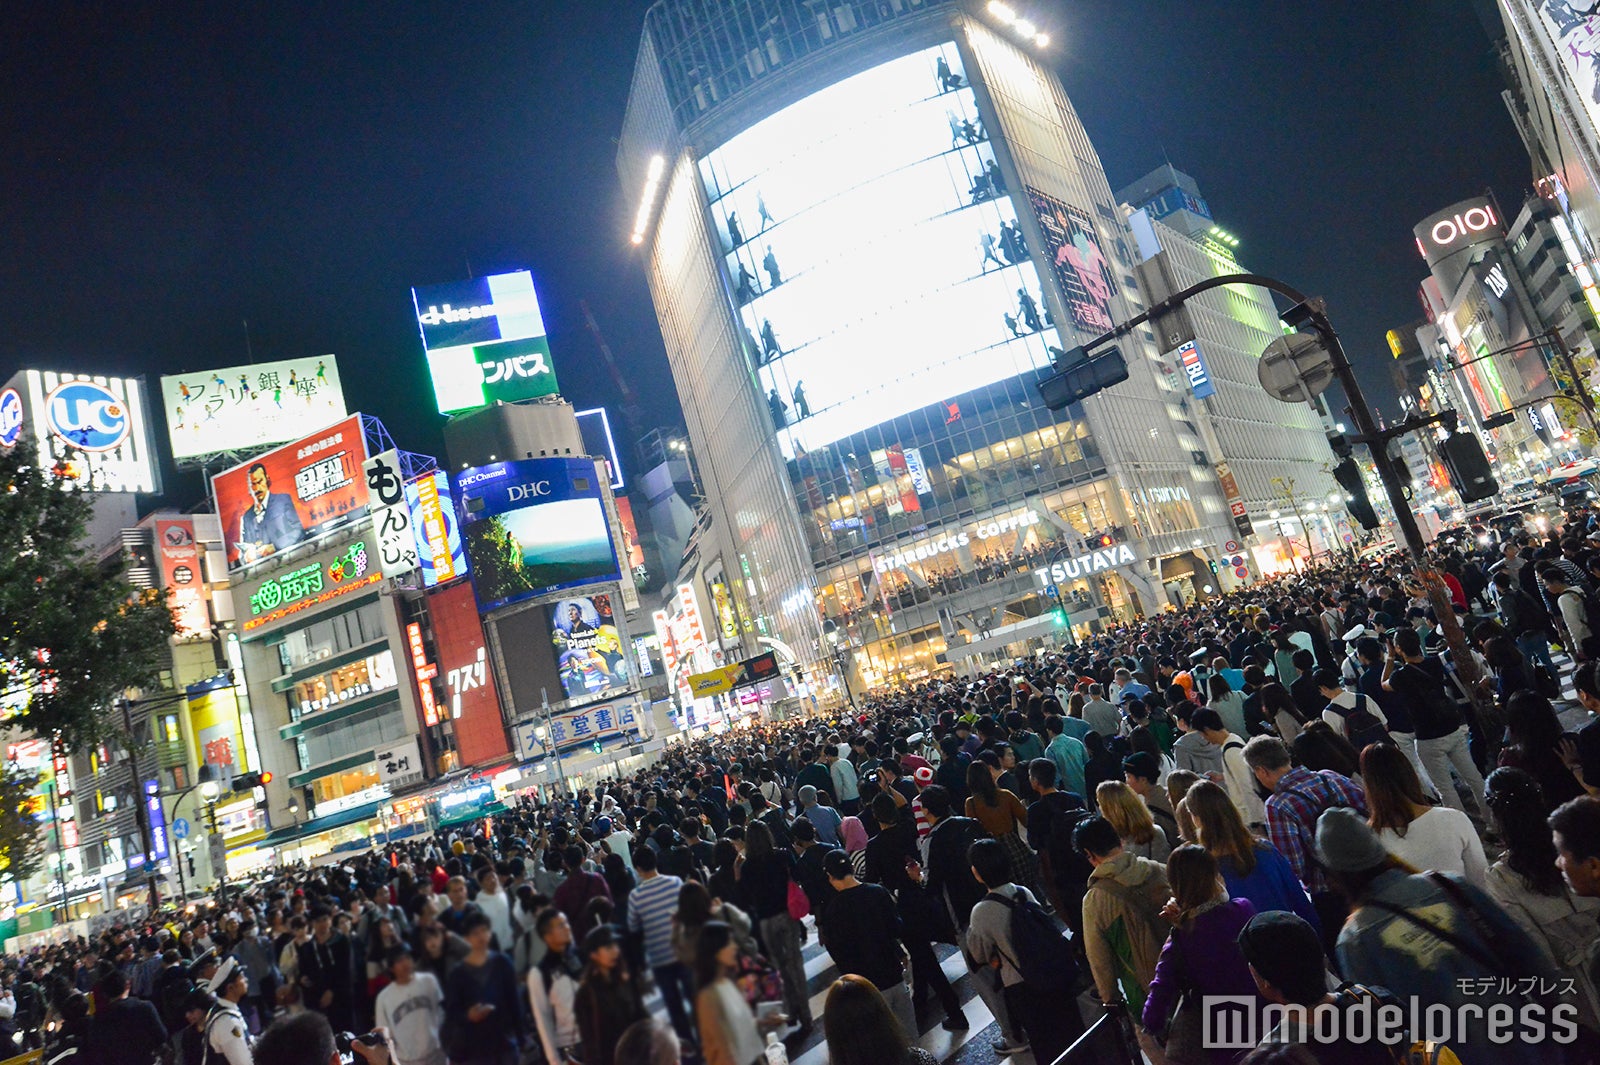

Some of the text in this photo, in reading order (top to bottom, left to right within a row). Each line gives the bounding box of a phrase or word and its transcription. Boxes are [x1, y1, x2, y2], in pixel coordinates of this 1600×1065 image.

[481, 353, 549, 384] ンパス
[1178, 340, 1208, 388] EIBU
[458, 467, 507, 488] DHC Channel
[506, 480, 551, 502] DHC
[367, 459, 416, 567] もんじゃ
[876, 510, 1040, 573] STARBUCKS COFFEE
[1035, 544, 1136, 587] TSUTAYA
[281, 570, 323, 602] 西村
[566, 635, 607, 650] Planets
[301, 682, 370, 714] Euphoria
[526, 704, 635, 751] 大盛堂書店
